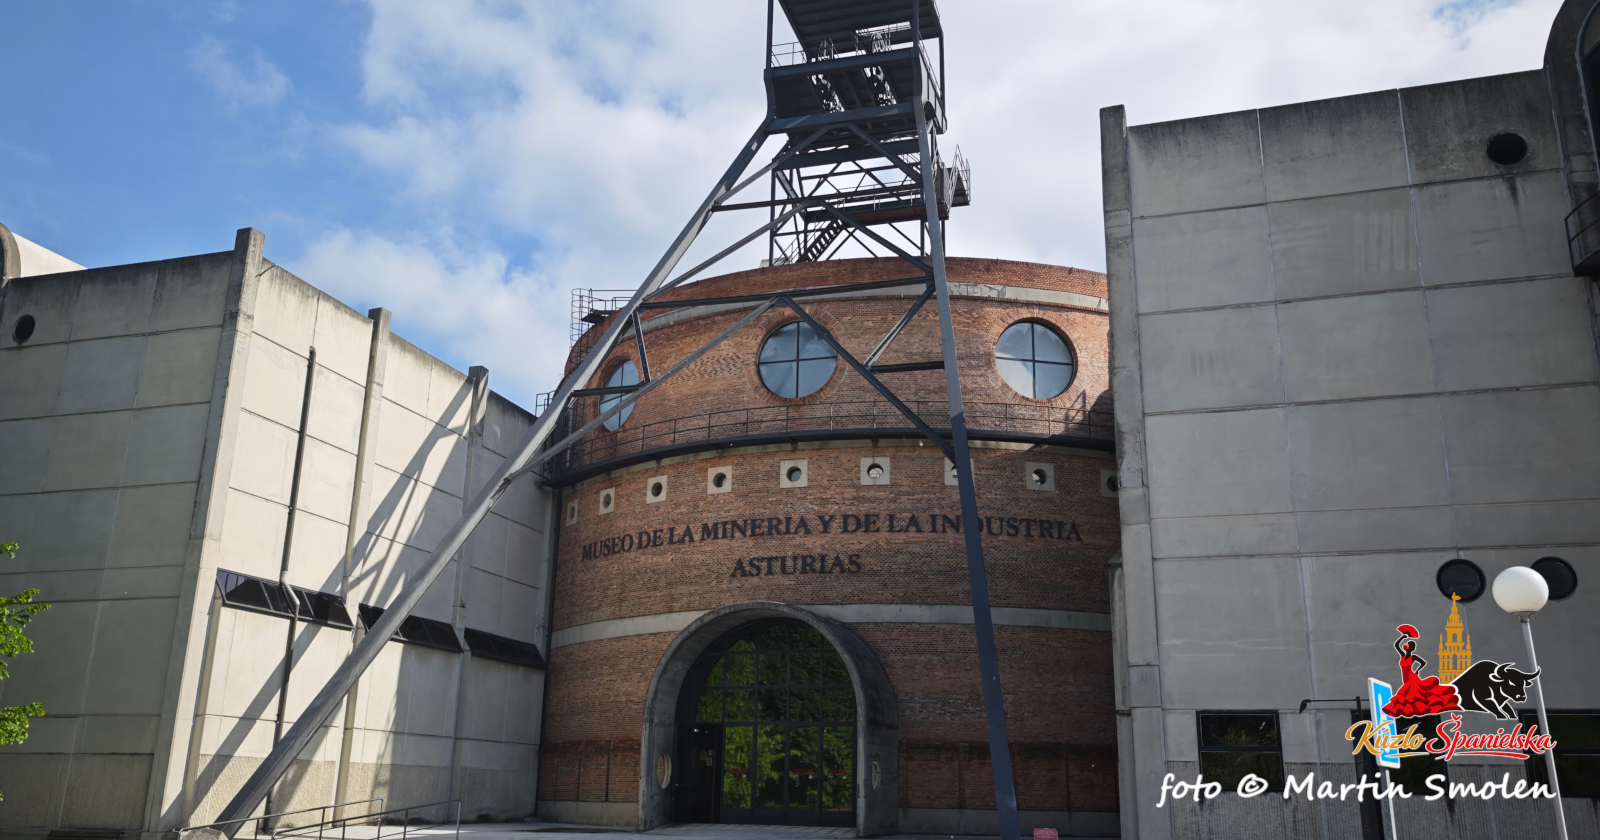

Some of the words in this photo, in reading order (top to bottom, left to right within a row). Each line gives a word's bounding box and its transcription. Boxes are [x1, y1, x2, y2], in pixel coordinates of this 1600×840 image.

[581, 533, 634, 562] MUSEO
[637, 529, 664, 549] DE
[667, 525, 695, 545] LA
[700, 516, 812, 542] MINERIA
[817, 515, 835, 533] Y
[842, 514, 880, 533] DE
[887, 514, 927, 533] LA
[929, 514, 1083, 542] INUSTRIA
[730, 553, 862, 578] ASTURIAS
